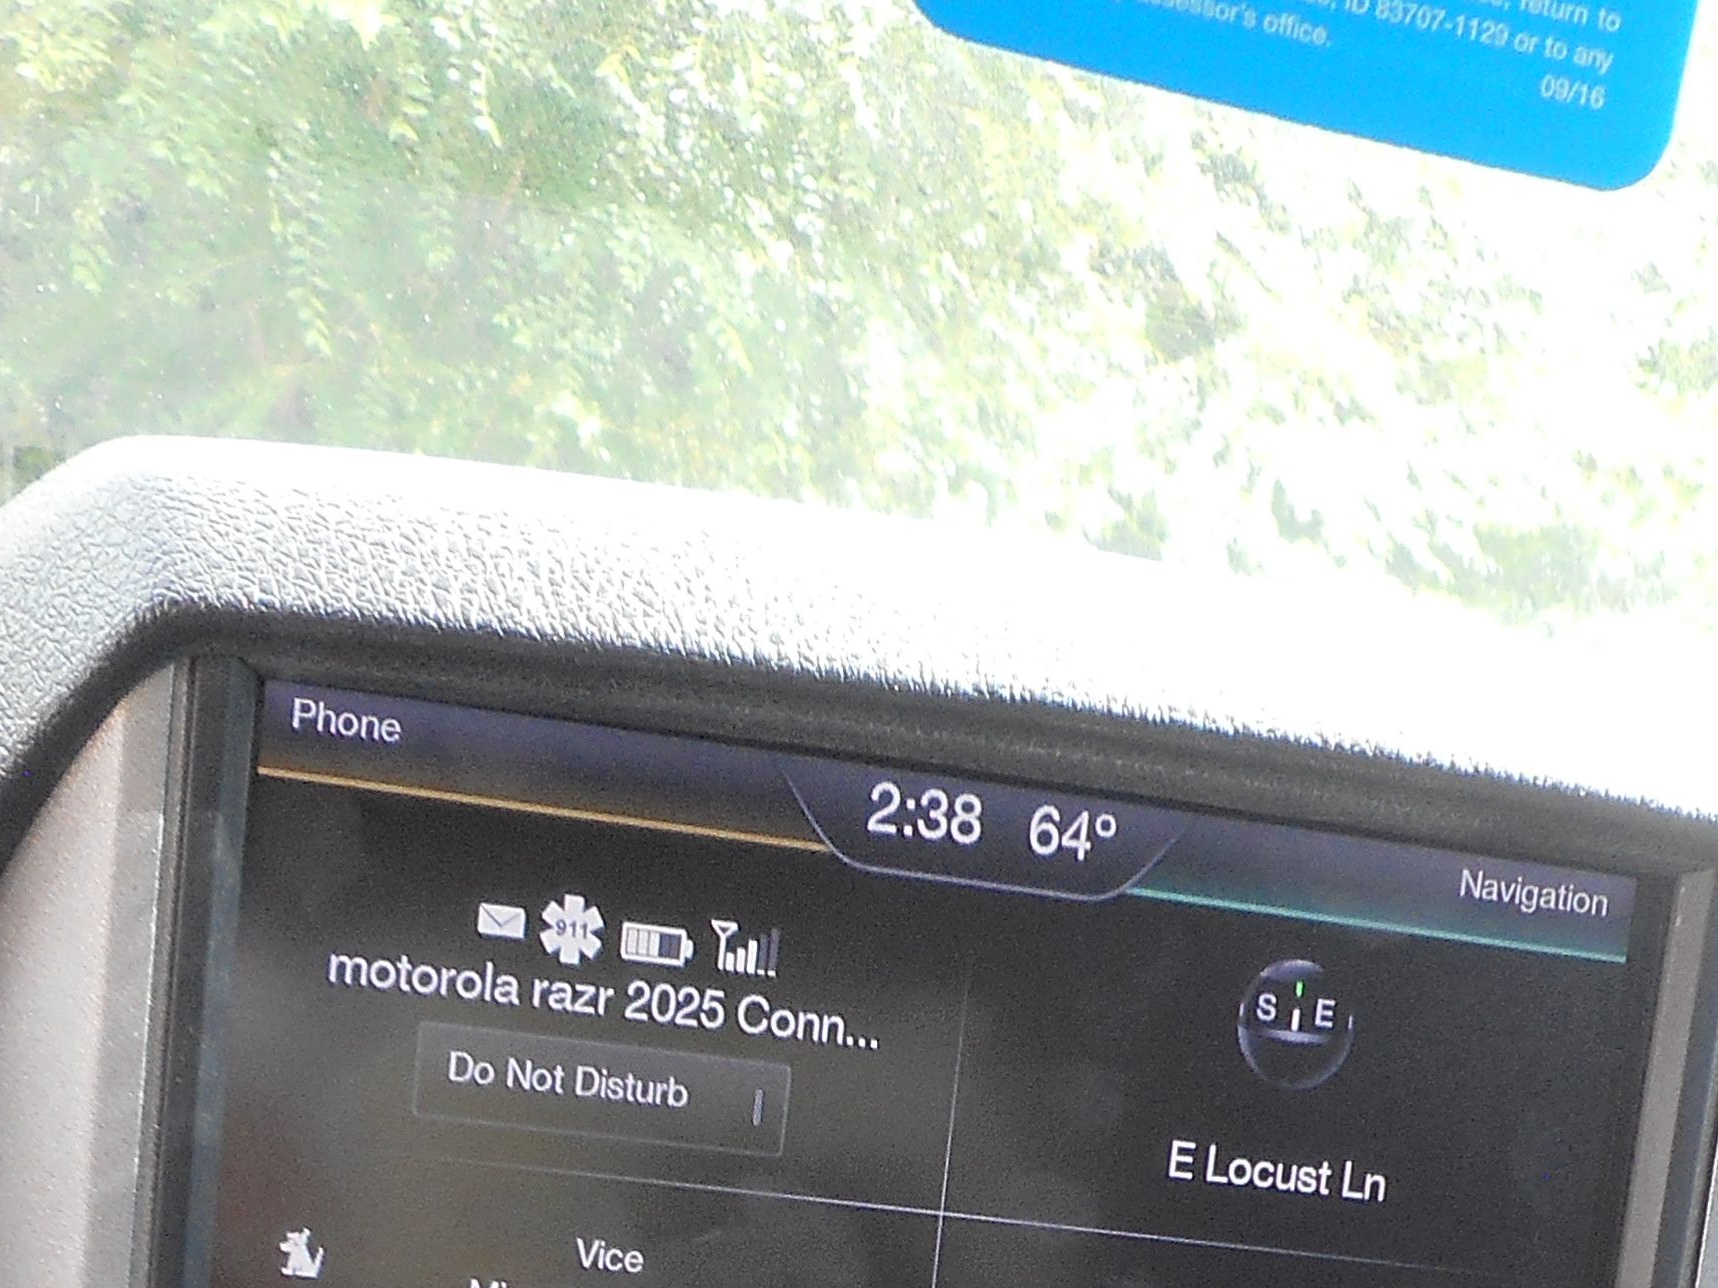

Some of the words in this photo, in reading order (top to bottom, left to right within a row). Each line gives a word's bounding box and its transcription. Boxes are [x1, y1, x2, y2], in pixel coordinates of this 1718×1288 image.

[1263, 11, 1332, 47] office.
[1374, 0, 1510, 48] 83707-1129
[1513, 32, 1541, 54] or
[1544, 35, 1569, 61] to
[1572, 45, 1614, 76] any
[1597, 7, 1622, 33] to
[1540, 74, 1607, 109] 09/16
[292, 697, 402, 742] Phone
[867, 781, 982, 845] 2:38
[1459, 868, 1608, 917] Navigation
[555, 914, 591, 944] 911
[328, 954, 520, 1006] motorola
[532, 978, 615, 1016] razr
[624, 979, 725, 1029] 2025
[737, 994, 878, 1050] Conn...
[1255, 992, 1279, 1022] S
[1314, 998, 1336, 1028] E
[448, 1050, 495, 1085] Do
[506, 1057, 565, 1094] Not
[575, 1065, 689, 1108] Disturb
[1168, 1139, 1197, 1180] E
[1206, 1143, 1332, 1196] Locust
[1341, 1160, 1386, 1202] Ln
[576, 1237, 644, 1273] Vice
